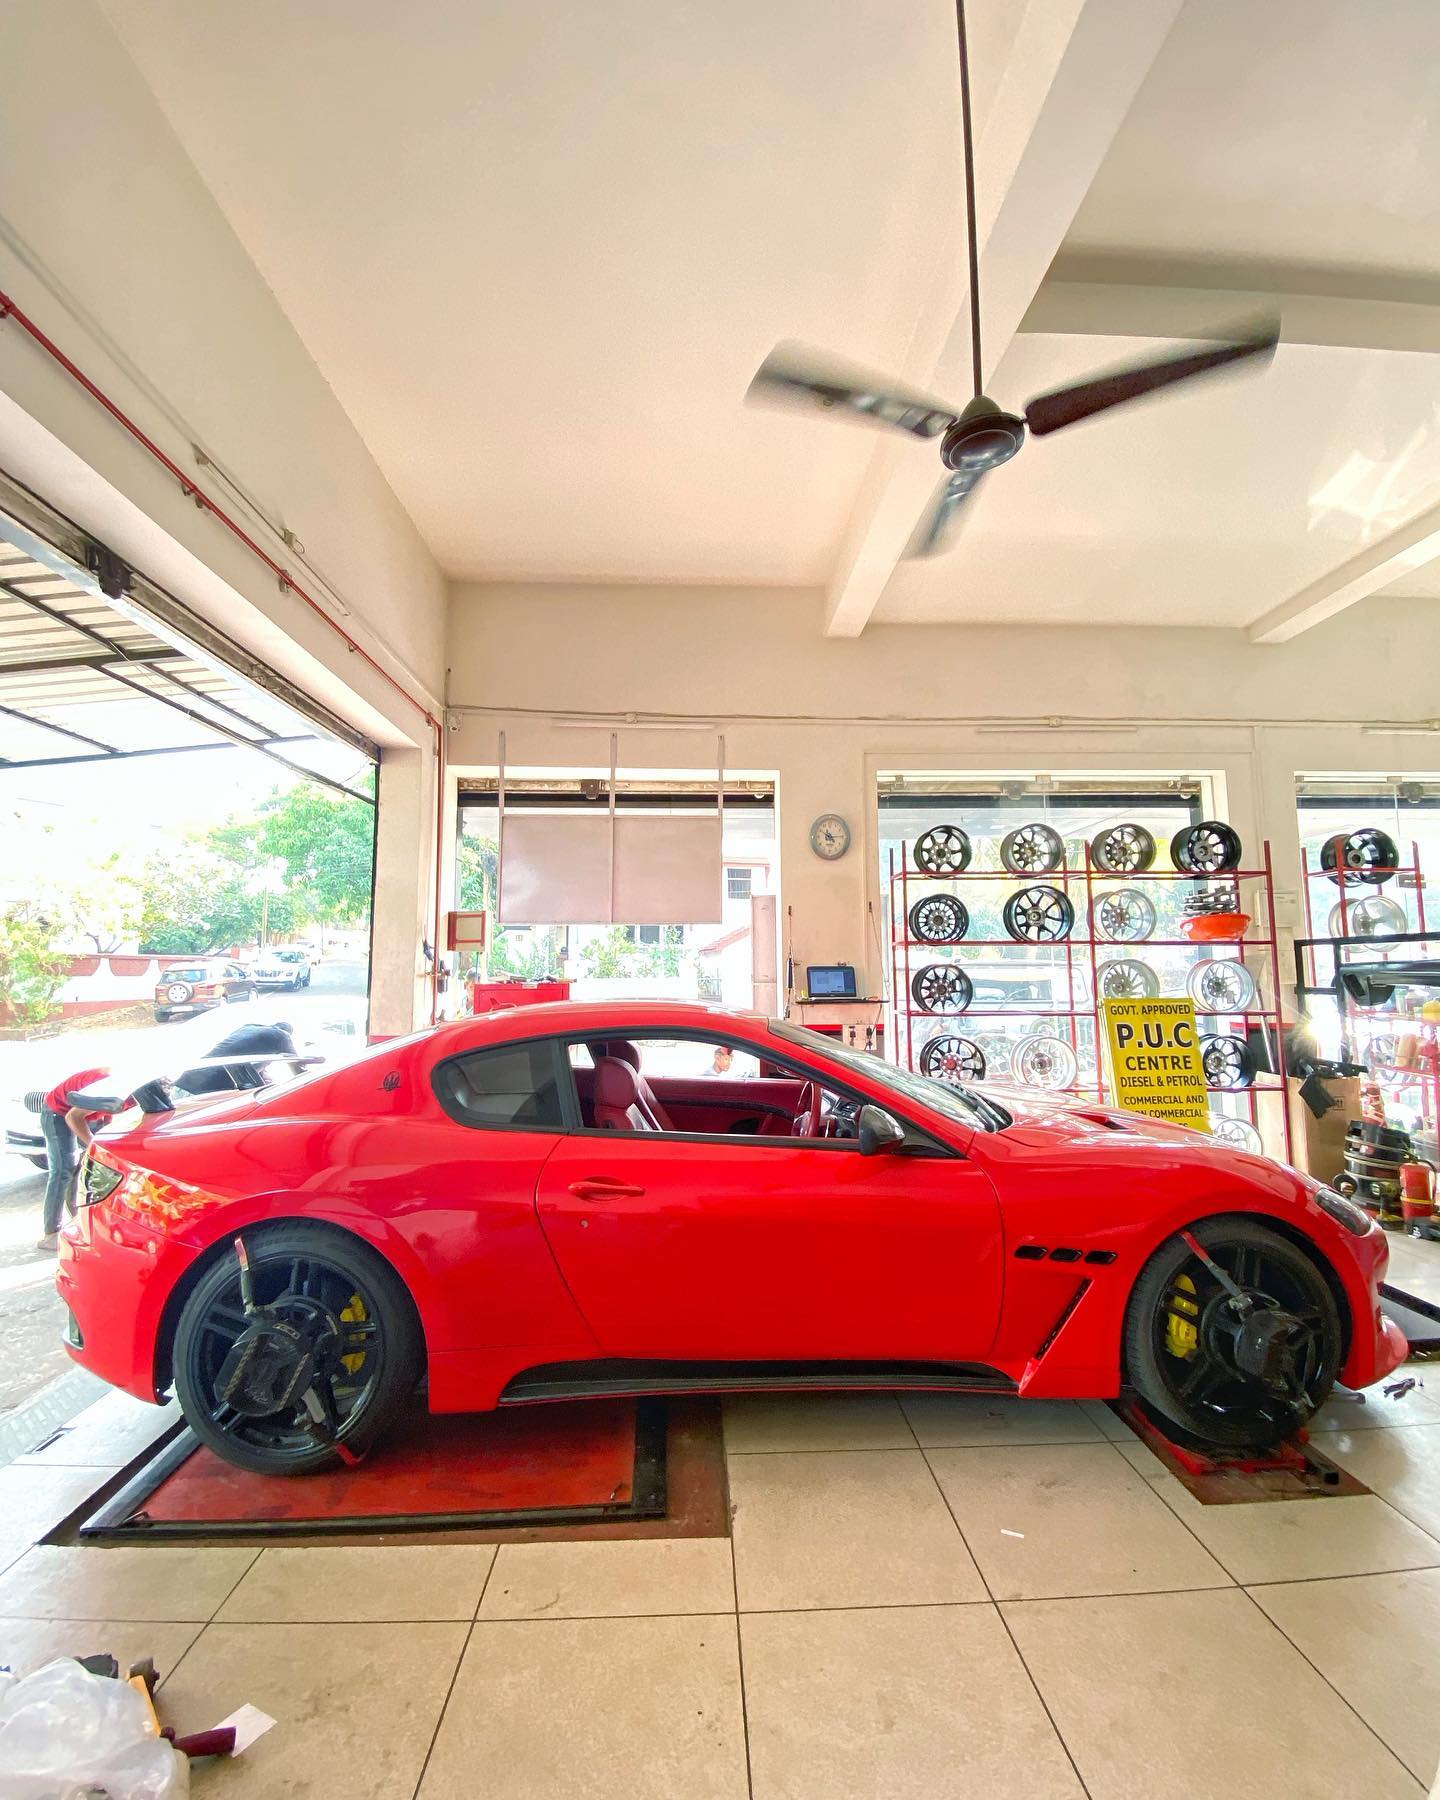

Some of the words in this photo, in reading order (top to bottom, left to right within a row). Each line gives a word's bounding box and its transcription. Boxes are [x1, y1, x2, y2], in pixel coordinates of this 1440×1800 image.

[1110, 1005, 1139, 1015] GOVT.
[1141, 1004, 1191, 1015] APPROVED
[1116, 1022, 1193, 1048] P.U.C
[1125, 1056, 1192, 1070] CENTRE
[1120, 1076, 1154, 1087] DIESEL
[1157, 1076, 1164, 1086] &
[1166, 1075, 1202, 1086] PETROL
[1124, 1095, 1184, 1105] COMMERCIAL
[1186, 1095, 1204, 1104] AND
[1149, 1109, 1203, 1118] COMMERCIAL
